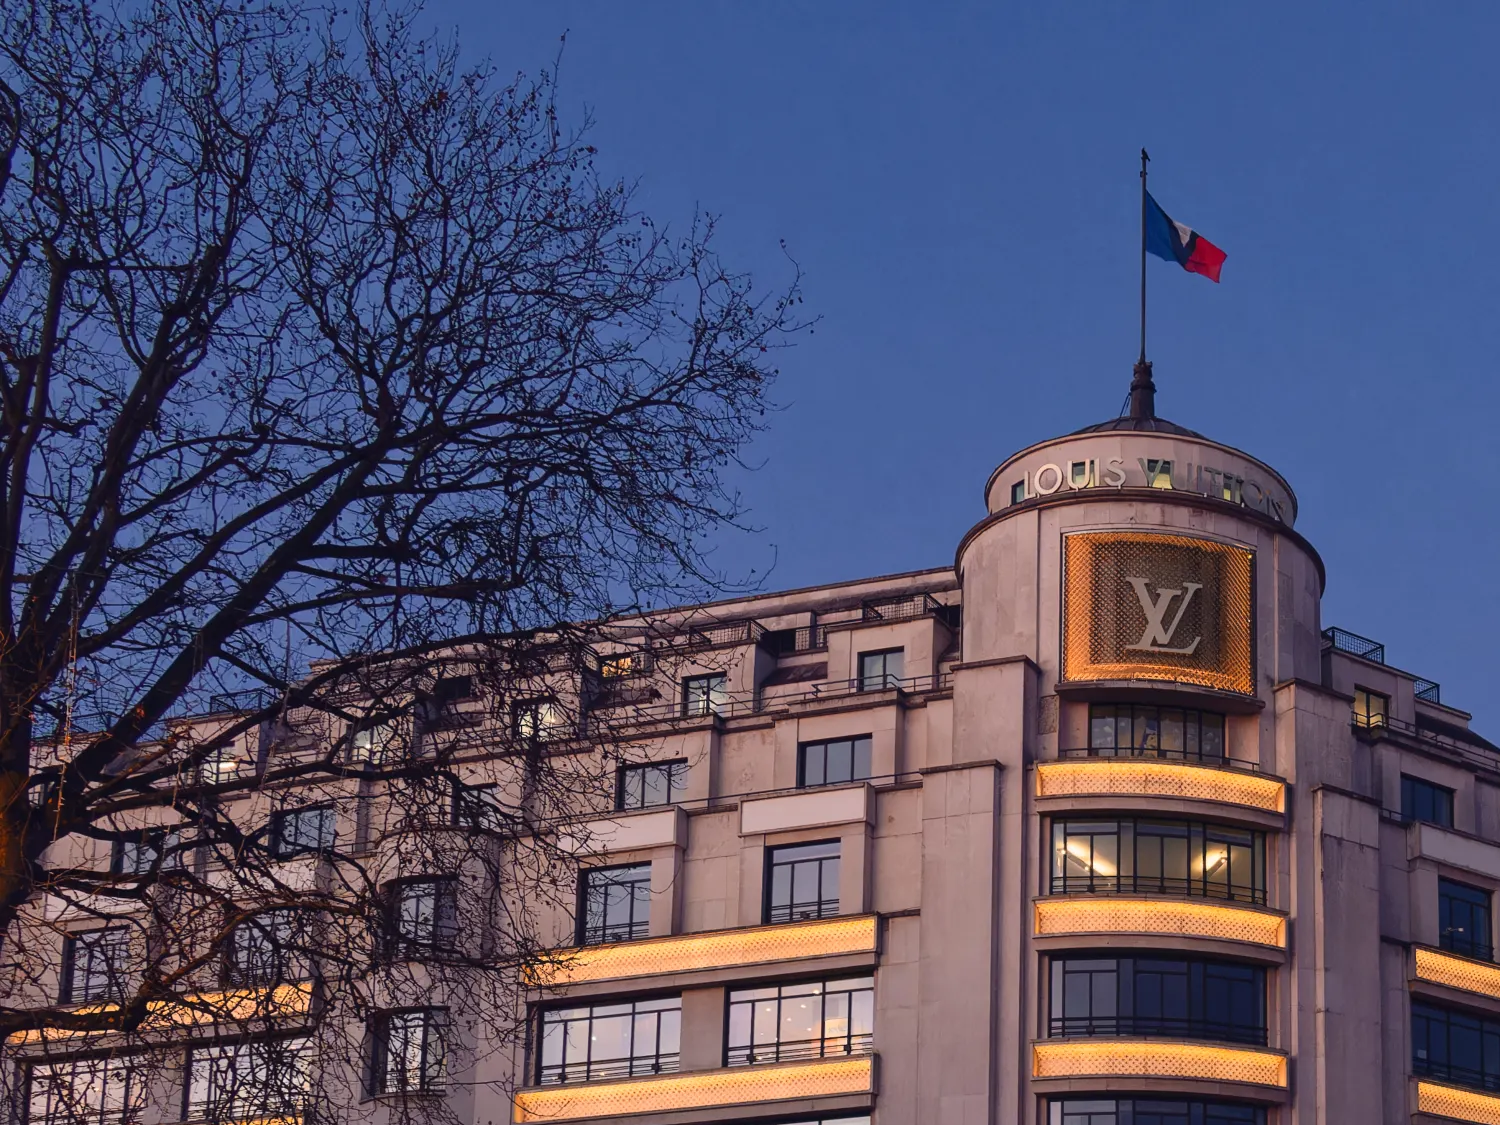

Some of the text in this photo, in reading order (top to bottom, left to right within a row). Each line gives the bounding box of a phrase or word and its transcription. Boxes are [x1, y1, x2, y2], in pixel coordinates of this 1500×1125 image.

[1024, 457, 1290, 528] LOUIS VUITTON
[1125, 577, 1203, 655] LV
